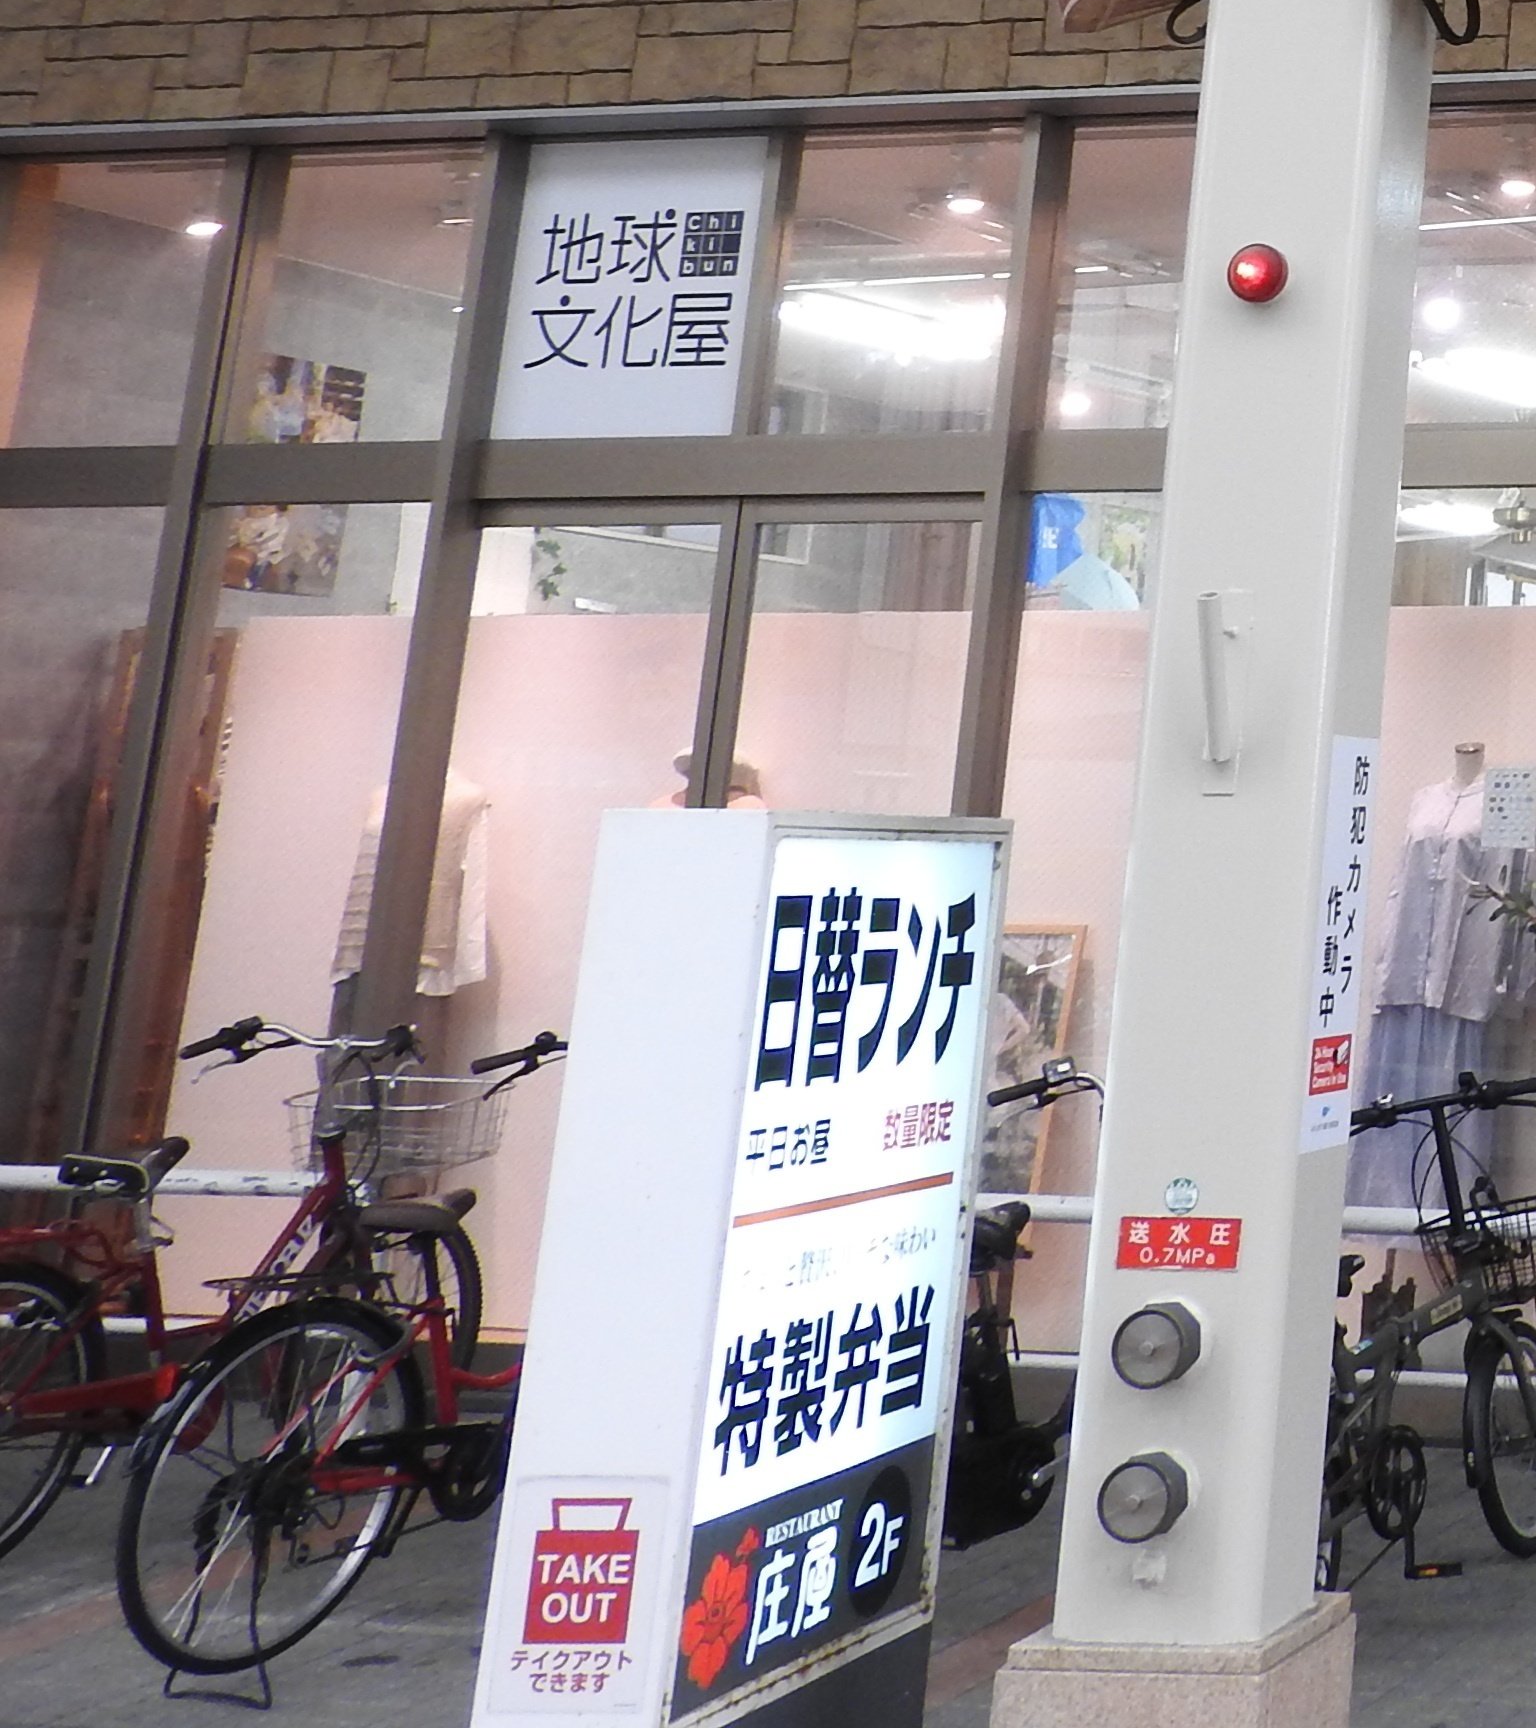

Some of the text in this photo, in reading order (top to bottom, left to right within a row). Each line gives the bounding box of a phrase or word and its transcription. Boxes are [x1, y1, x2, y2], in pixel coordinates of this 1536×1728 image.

[536, 208, 677, 285] 地球
[681, 258, 734, 275] bun
[522, 292, 733, 370] 文化屋
[1341, 755, 1371, 994] 防犯カメラ
[754, 886, 976, 1093] 日替ランチ
[1319, 885, 1343, 1029] 作動中
[745, 1098, 955, 1173] 平日お昼 数量限定
[1139, 1246, 1216, 1265] 0.7MPa
[714, 1283, 936, 1477] 特製弁当
[764, 1498, 844, 1548] RESTAURANT
[854, 1502, 904, 1588] 2F
[536, 1552, 632, 1586] TAKE
[541, 1591, 618, 1624] OUT
[510, 1650, 633, 1674] テイクアウト
[528, 1671, 611, 1694] できます
